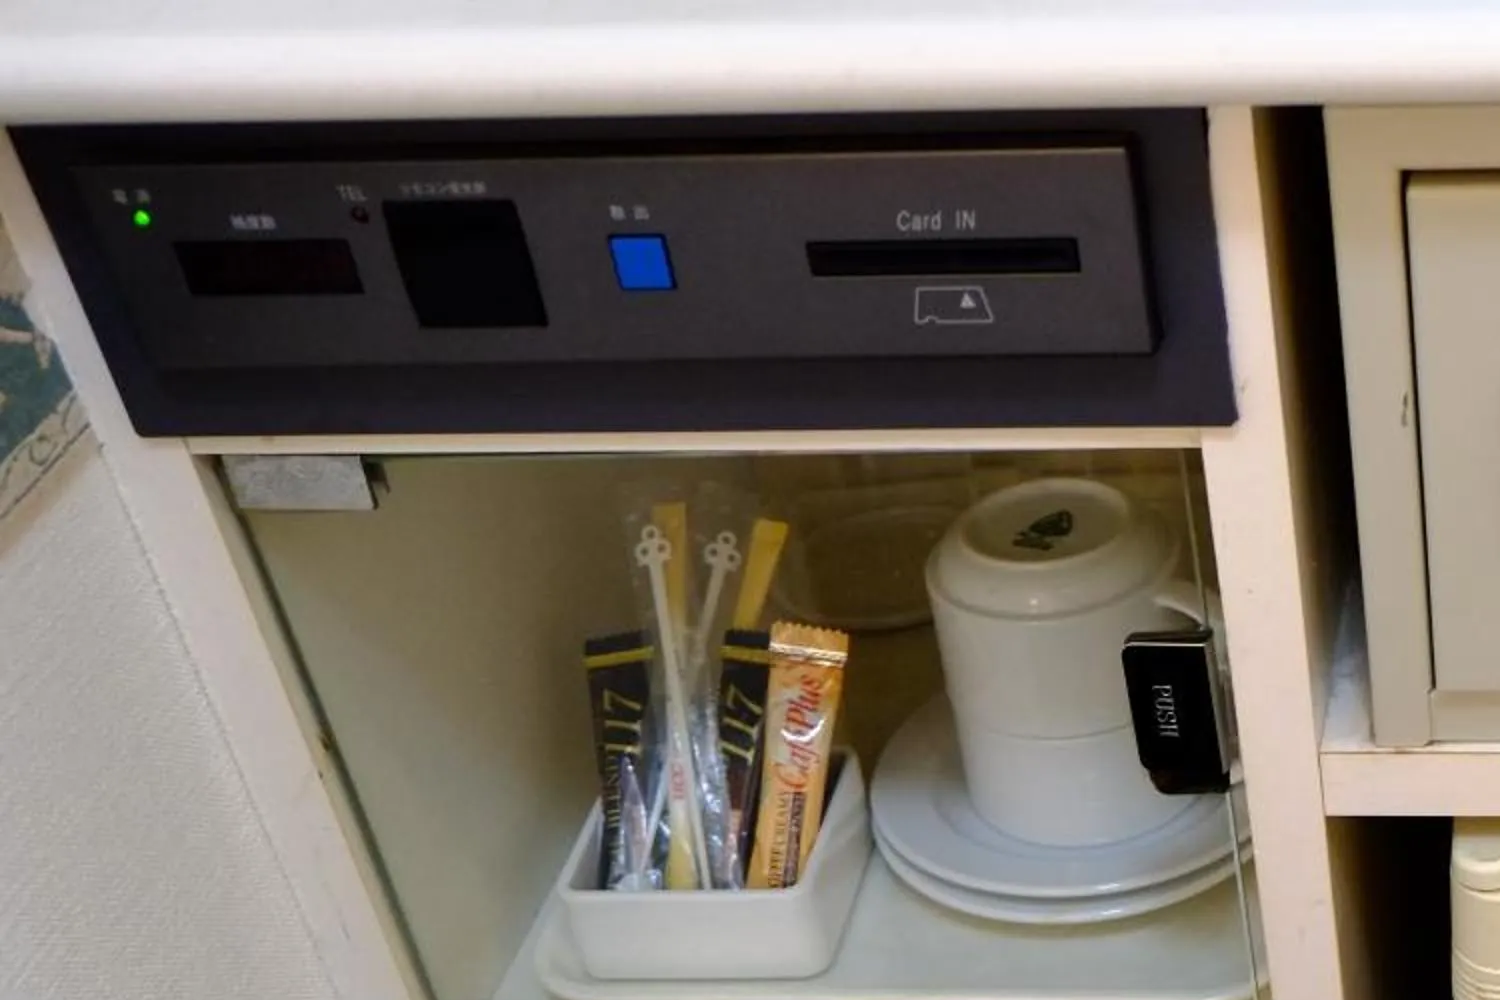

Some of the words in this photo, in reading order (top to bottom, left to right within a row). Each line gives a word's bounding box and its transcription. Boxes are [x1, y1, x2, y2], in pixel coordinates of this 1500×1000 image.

[896, 210, 942, 232] Card
[955, 211, 977, 230] IN
[603, 688, 643, 757] 117
[721, 684, 764, 761] 117
[780, 674, 822, 729] Plus
[1151, 684, 1181, 739] PUSH
